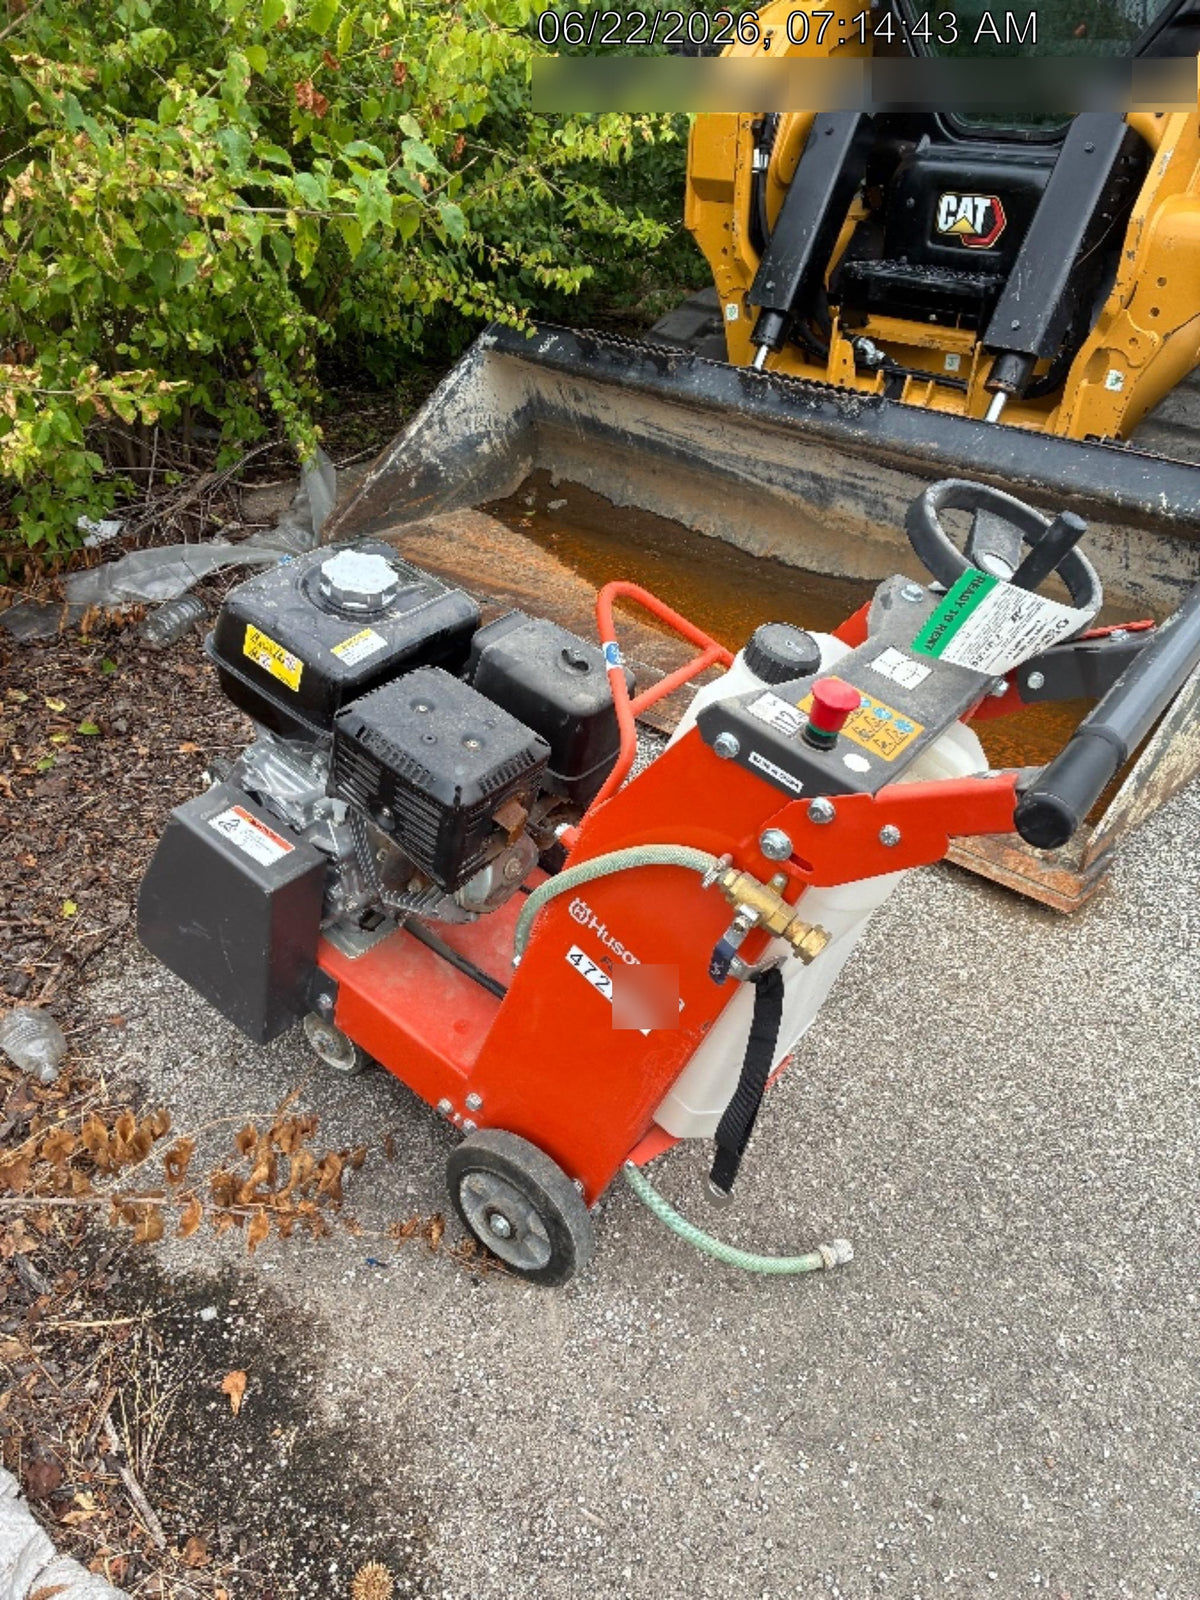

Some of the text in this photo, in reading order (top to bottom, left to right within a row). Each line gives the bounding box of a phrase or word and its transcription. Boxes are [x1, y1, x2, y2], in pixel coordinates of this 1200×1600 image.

[939, 195, 992, 234] CAT
[954, 574, 986, 609] READY
[944, 610, 959, 623] TO
[923, 624, 948, 651] RENT
[569, 953, 612, 1000] 472
